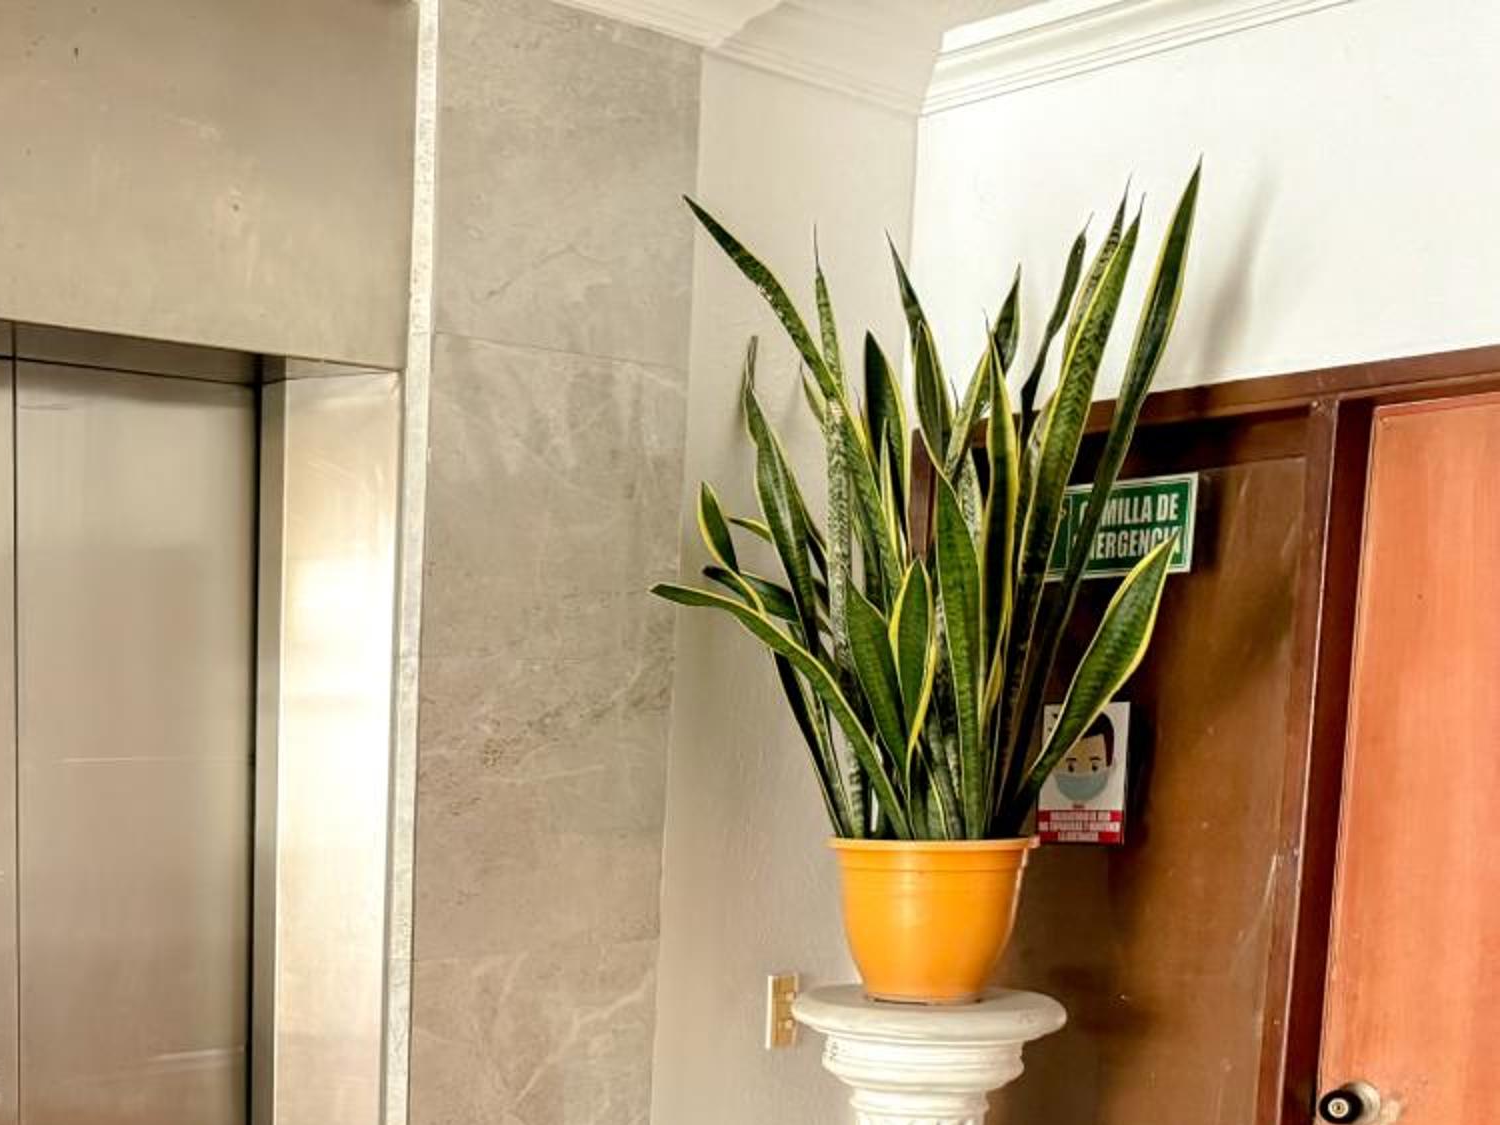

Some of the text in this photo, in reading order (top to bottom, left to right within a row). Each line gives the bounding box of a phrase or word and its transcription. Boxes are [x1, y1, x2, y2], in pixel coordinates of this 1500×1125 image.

[1079, 493, 1179, 527] MILLA DE
[1073, 526, 1181, 560] ERGENC
